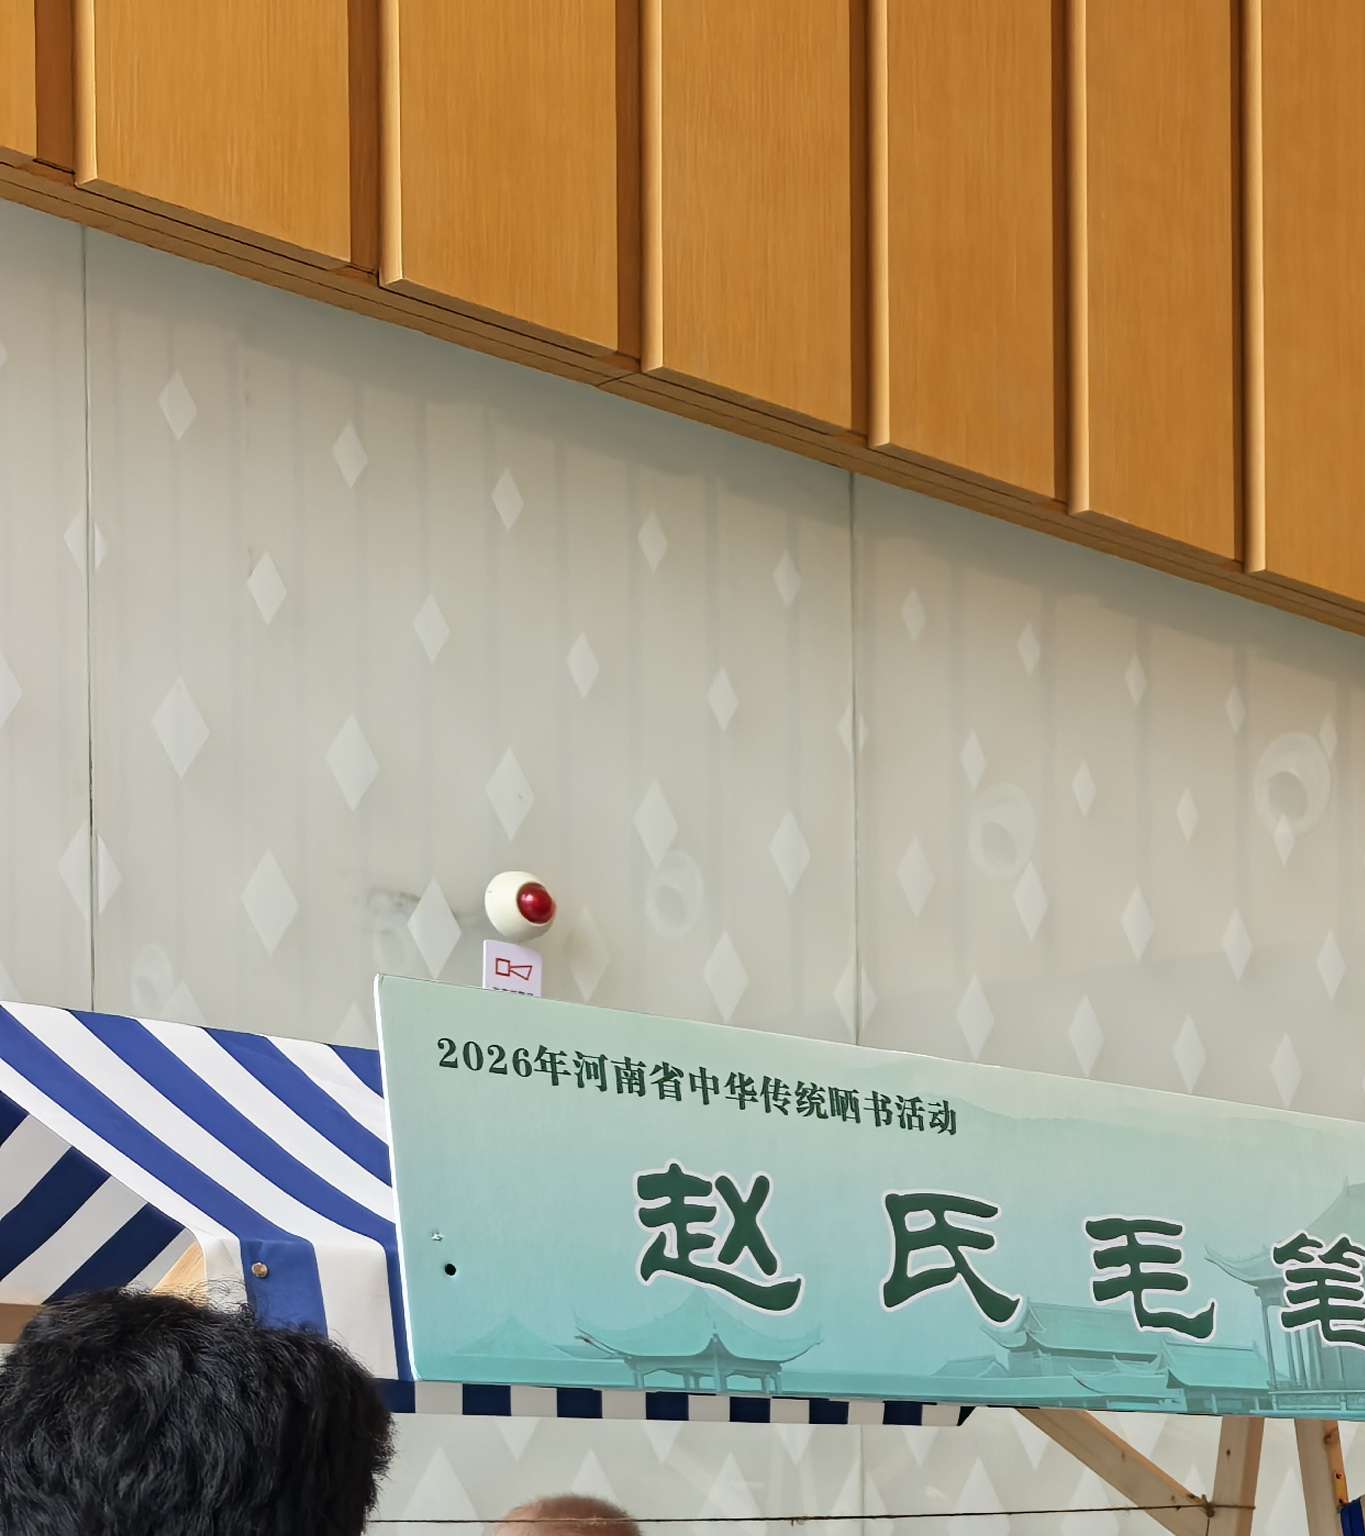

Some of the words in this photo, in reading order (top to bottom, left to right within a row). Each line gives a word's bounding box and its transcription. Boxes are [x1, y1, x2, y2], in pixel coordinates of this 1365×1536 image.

[437, 1037, 957, 1136] 2026年河南省中华传统晒书活动
